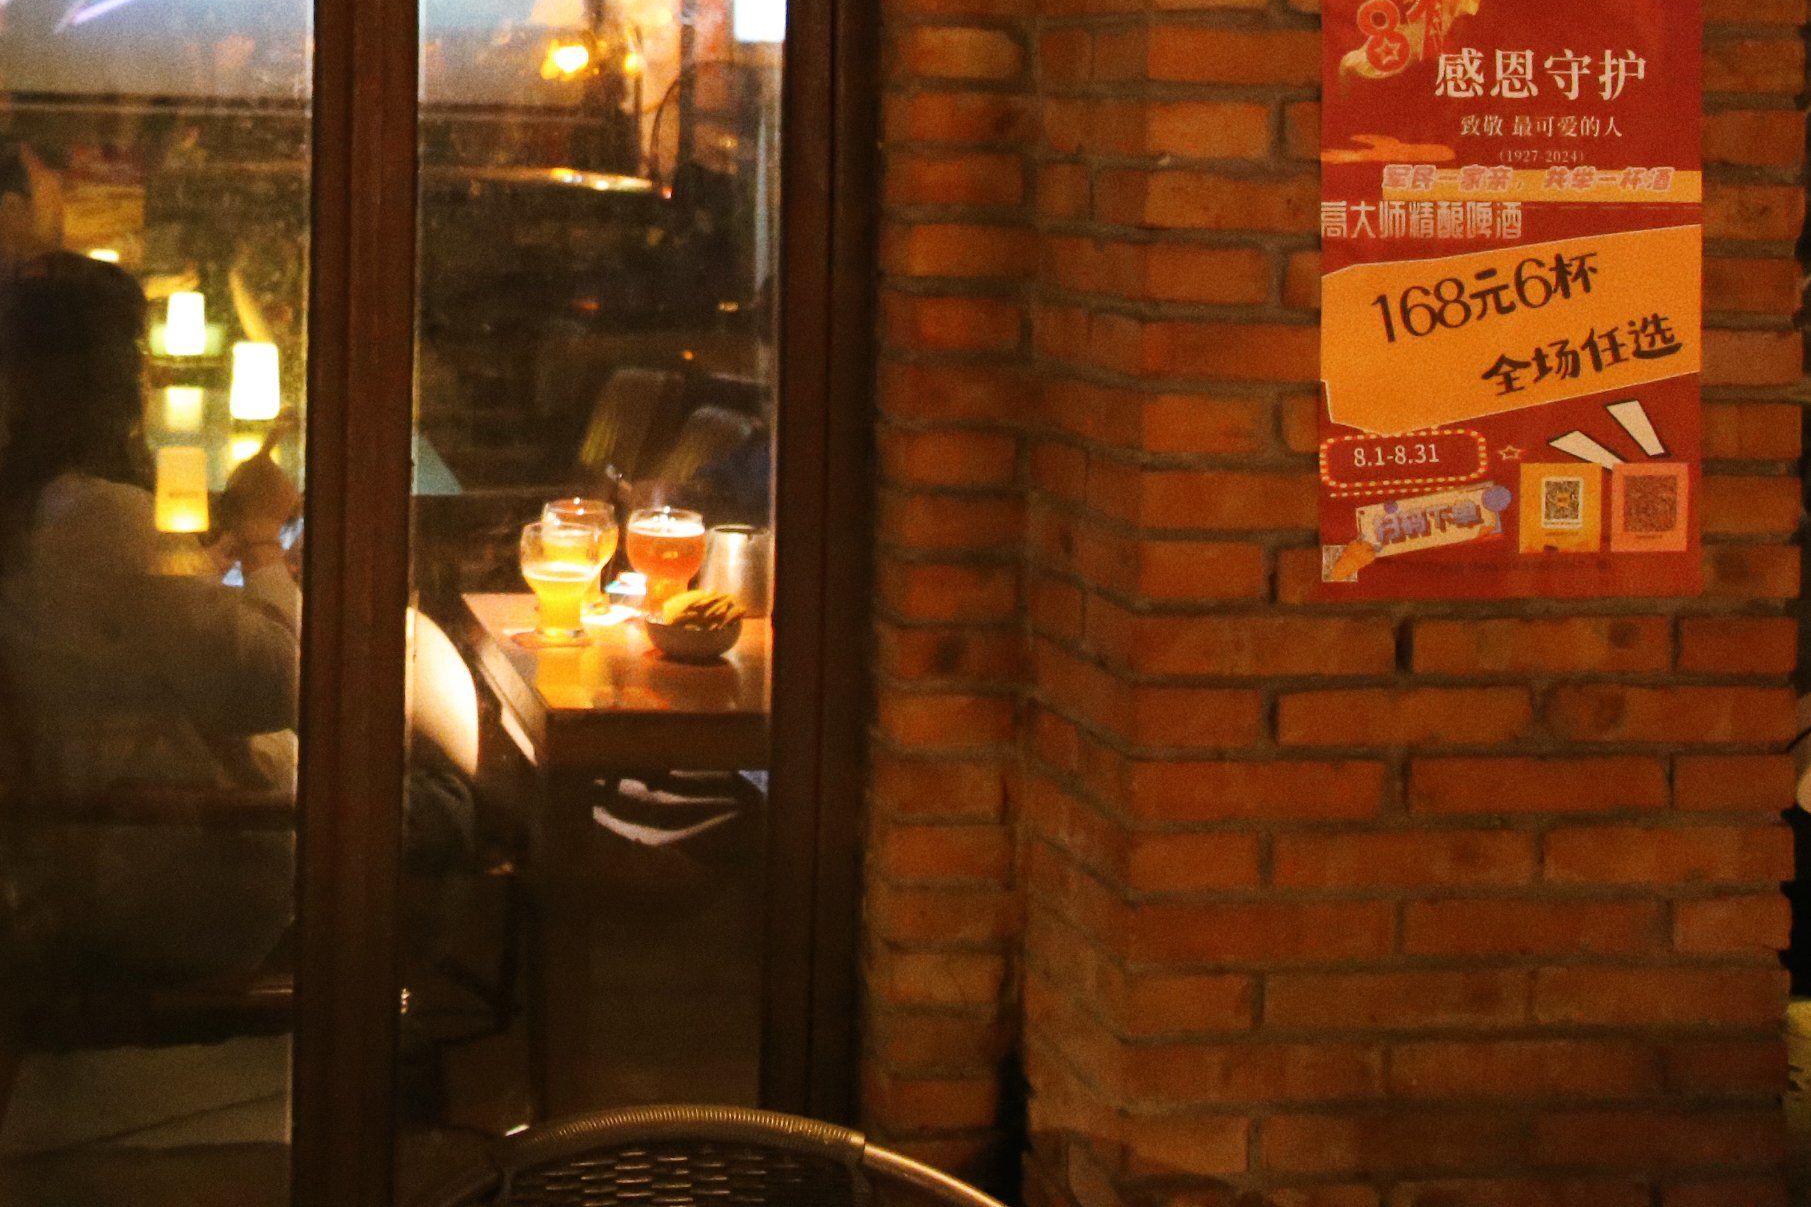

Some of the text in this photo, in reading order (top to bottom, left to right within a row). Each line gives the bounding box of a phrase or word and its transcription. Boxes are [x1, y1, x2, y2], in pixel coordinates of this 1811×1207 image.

[1435, 47, 1647, 101] 感恩守护
[1372, 251, 1598, 343] 168元6杯
[1481, 312, 1683, 397] 全场任选
[1353, 443, 1440, 468] 8.1-8.31
